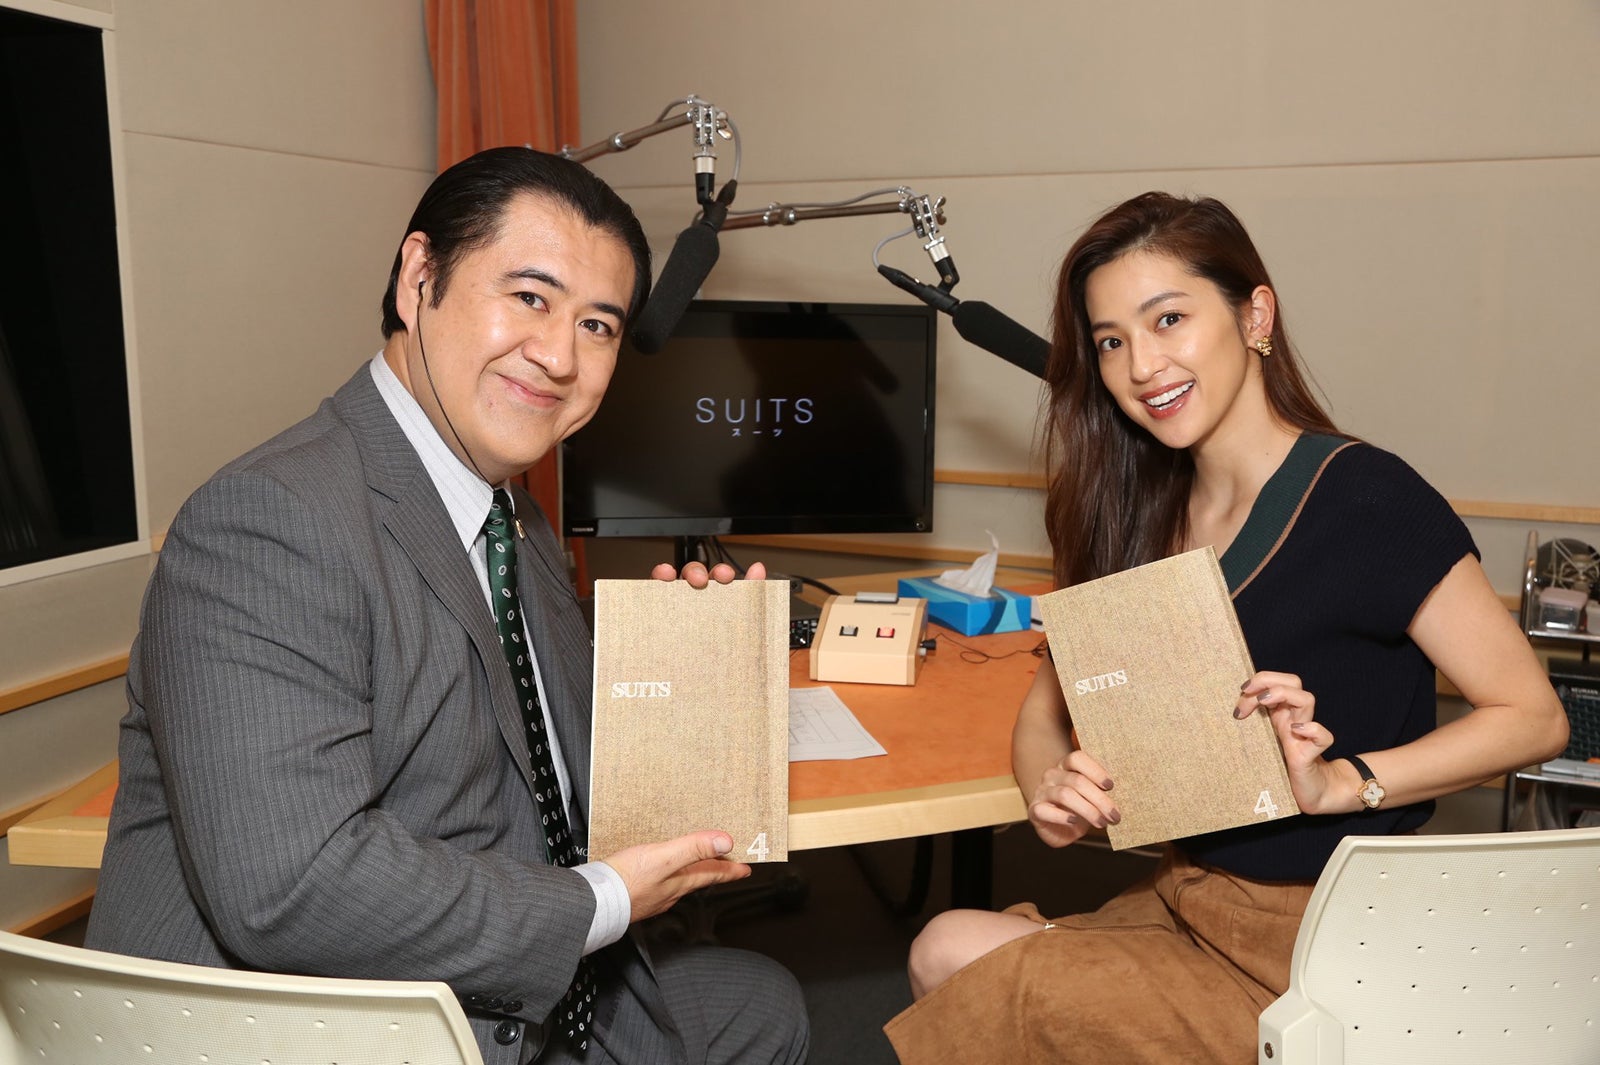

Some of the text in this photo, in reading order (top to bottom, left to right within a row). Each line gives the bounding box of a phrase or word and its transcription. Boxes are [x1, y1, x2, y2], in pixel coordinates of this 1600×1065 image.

[696, 397, 814, 424] SUITS
[731, 427, 783, 438] スーツ
[611, 681, 672, 698] SUITS
[1075, 669, 1128, 696] SUITS
[1253, 790, 1278, 819] 4
[746, 832, 770, 862] 4
